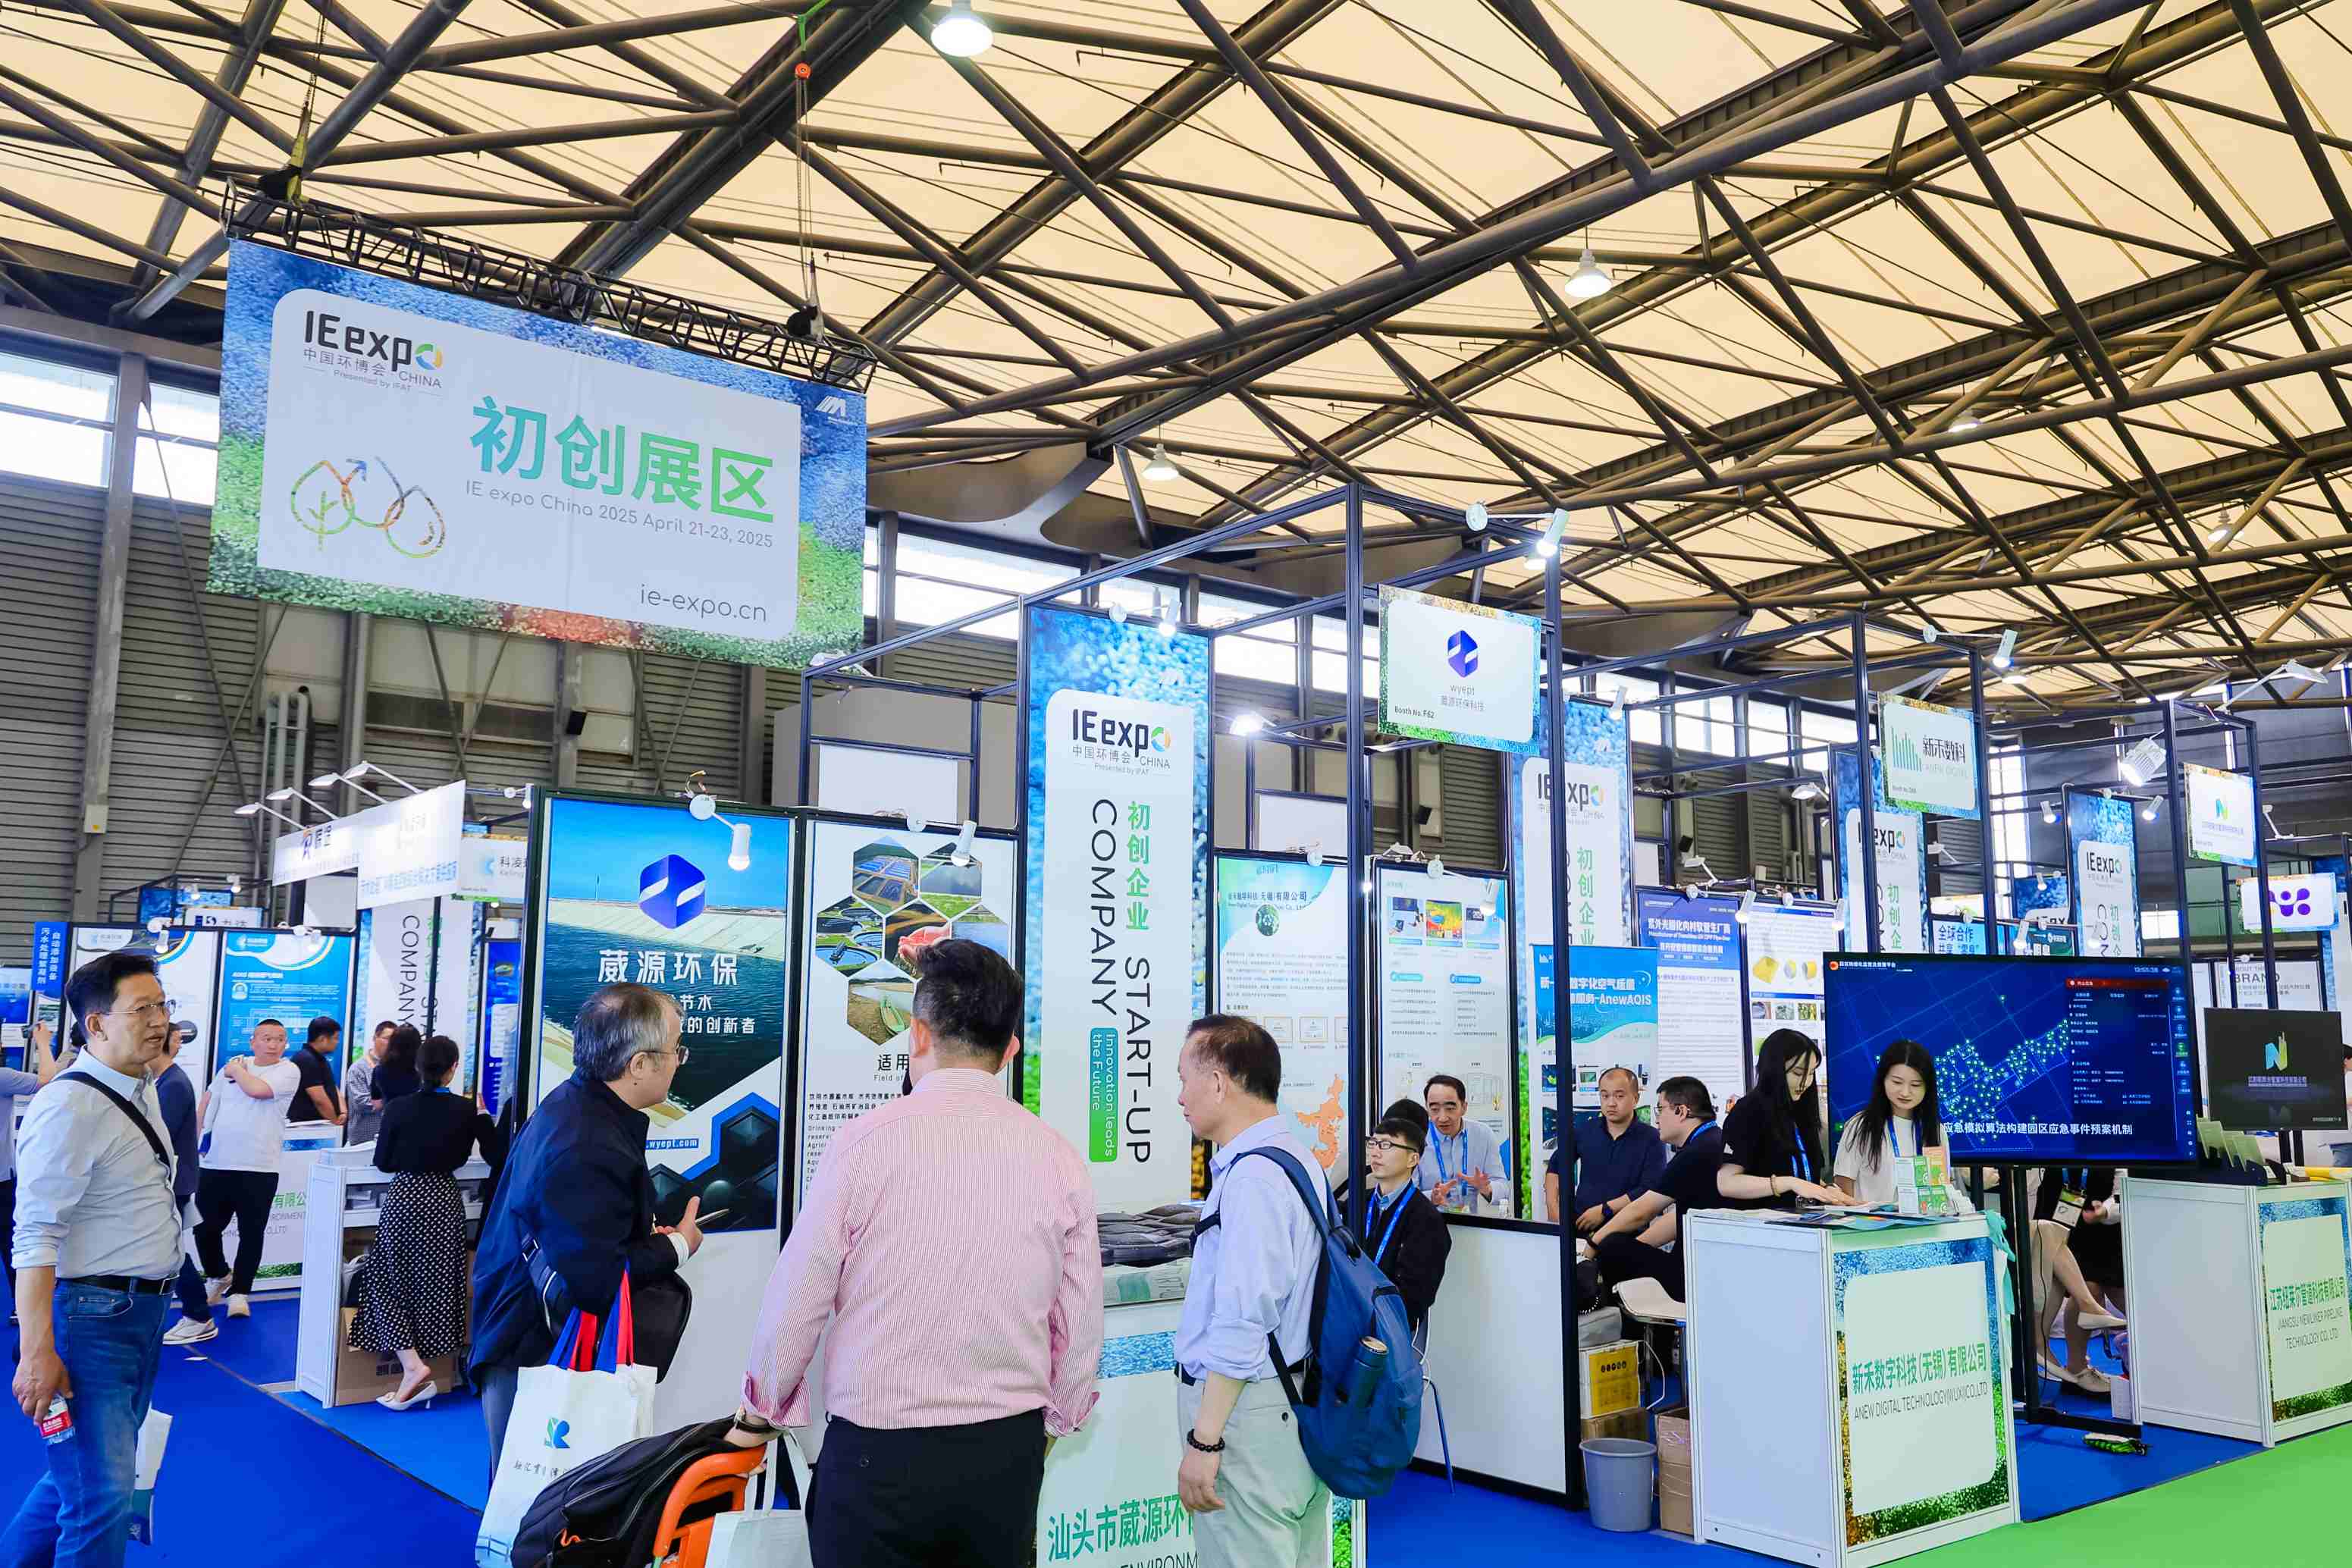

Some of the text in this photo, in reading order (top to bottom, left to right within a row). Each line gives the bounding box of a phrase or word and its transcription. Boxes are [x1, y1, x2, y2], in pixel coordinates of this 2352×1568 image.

[303, 347, 387, 377] 中国环博会
[398, 370, 442, 388] CHINA
[379, 380, 390, 389] by
[470, 395, 774, 523] 初创展区
[466, 479, 773, 548] IE expo China 2025 April 21-23, 2025
[640, 584, 767, 623] ie-expo.cn
[1073, 746, 1131, 764] 中国环博会
[1140, 755, 1171, 769] CHINA
[1923, 735, 1966, 764] 新禾数科
[1126, 801, 1151, 930] 初创企业
[1090, 799, 1117, 1016] COMPANY
[1938, 924, 1974, 942] 全球合作
[597, 949, 739, 986] 葳源环保
[1092, 1033, 1103, 1111] the Future
[1124, 955, 1151, 1163] START-UP
[1105, 1033, 1116, 1157] Innovation leads
[1855, 1403, 1875, 1420] ANEW
[1876, 1399, 1901, 1417] DIGITAL
